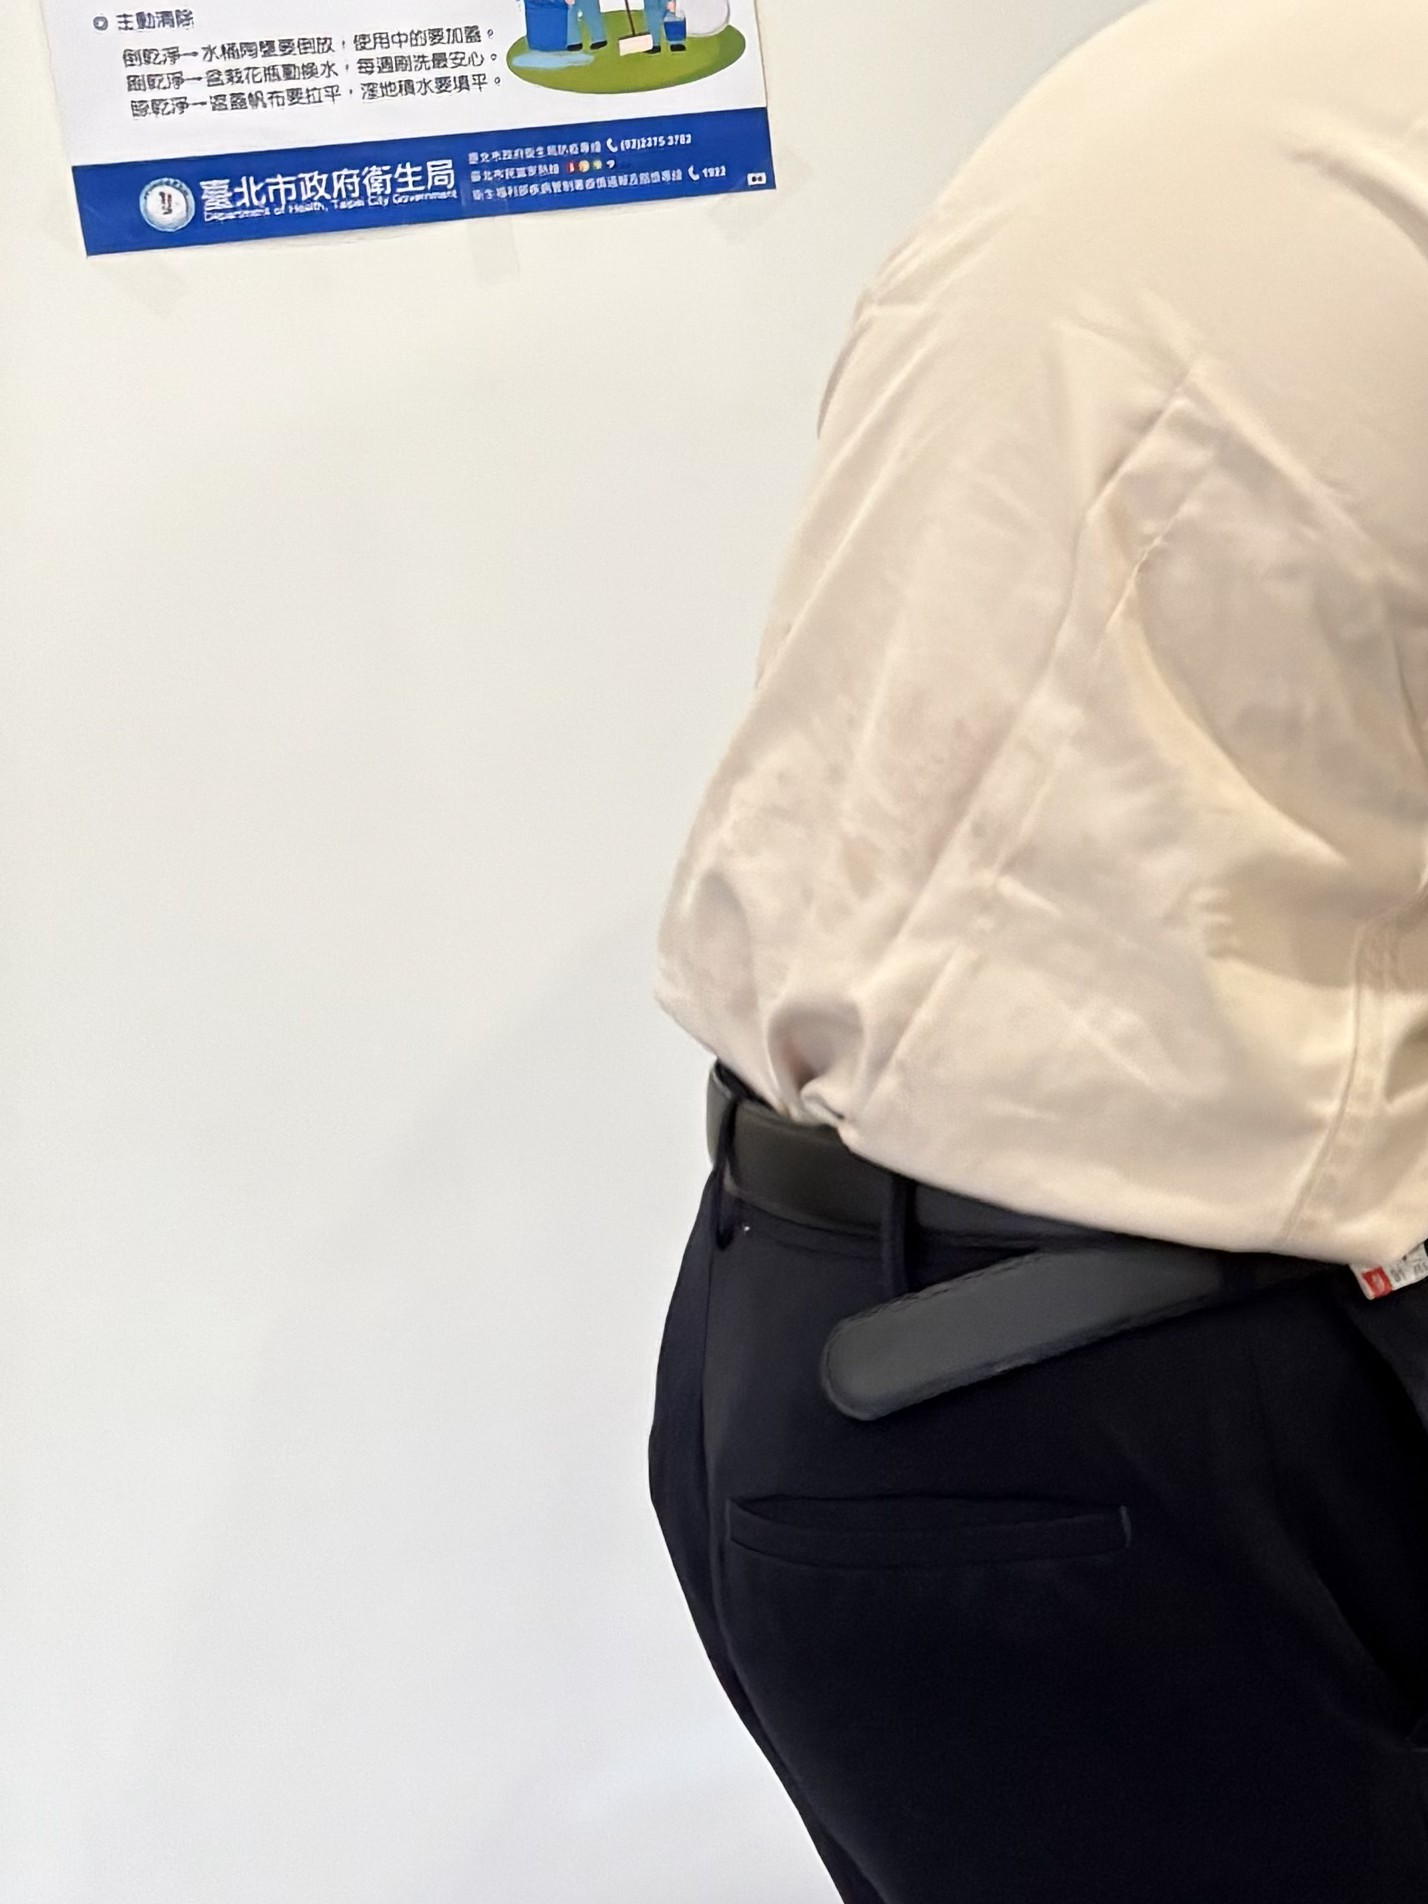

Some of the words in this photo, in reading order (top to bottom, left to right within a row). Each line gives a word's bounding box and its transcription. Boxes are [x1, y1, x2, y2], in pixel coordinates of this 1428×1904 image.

[199, 159, 455, 211] 臺北市政府衛生局
